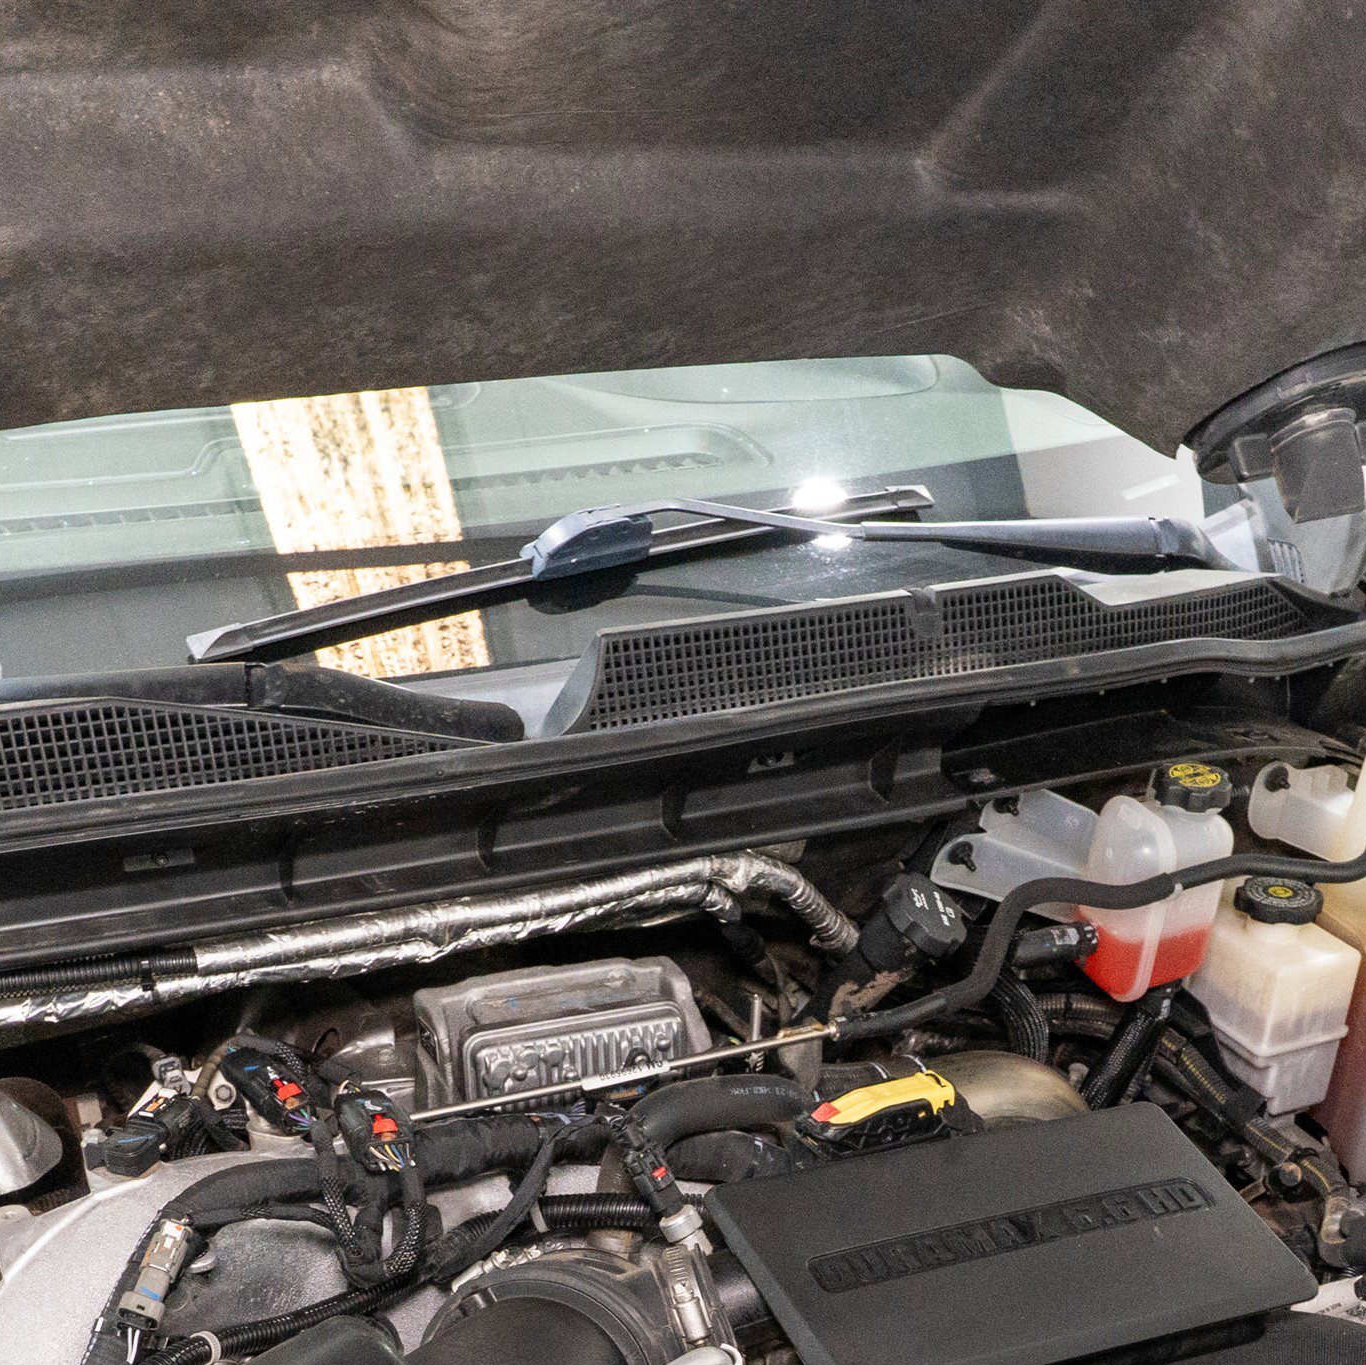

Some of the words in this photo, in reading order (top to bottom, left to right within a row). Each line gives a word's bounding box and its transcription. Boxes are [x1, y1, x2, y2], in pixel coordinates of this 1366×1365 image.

[821, 1211, 1059, 1288] DURAMAX
[1062, 1197, 1133, 1232] 6.6
[1136, 1186, 1206, 1216] HD
